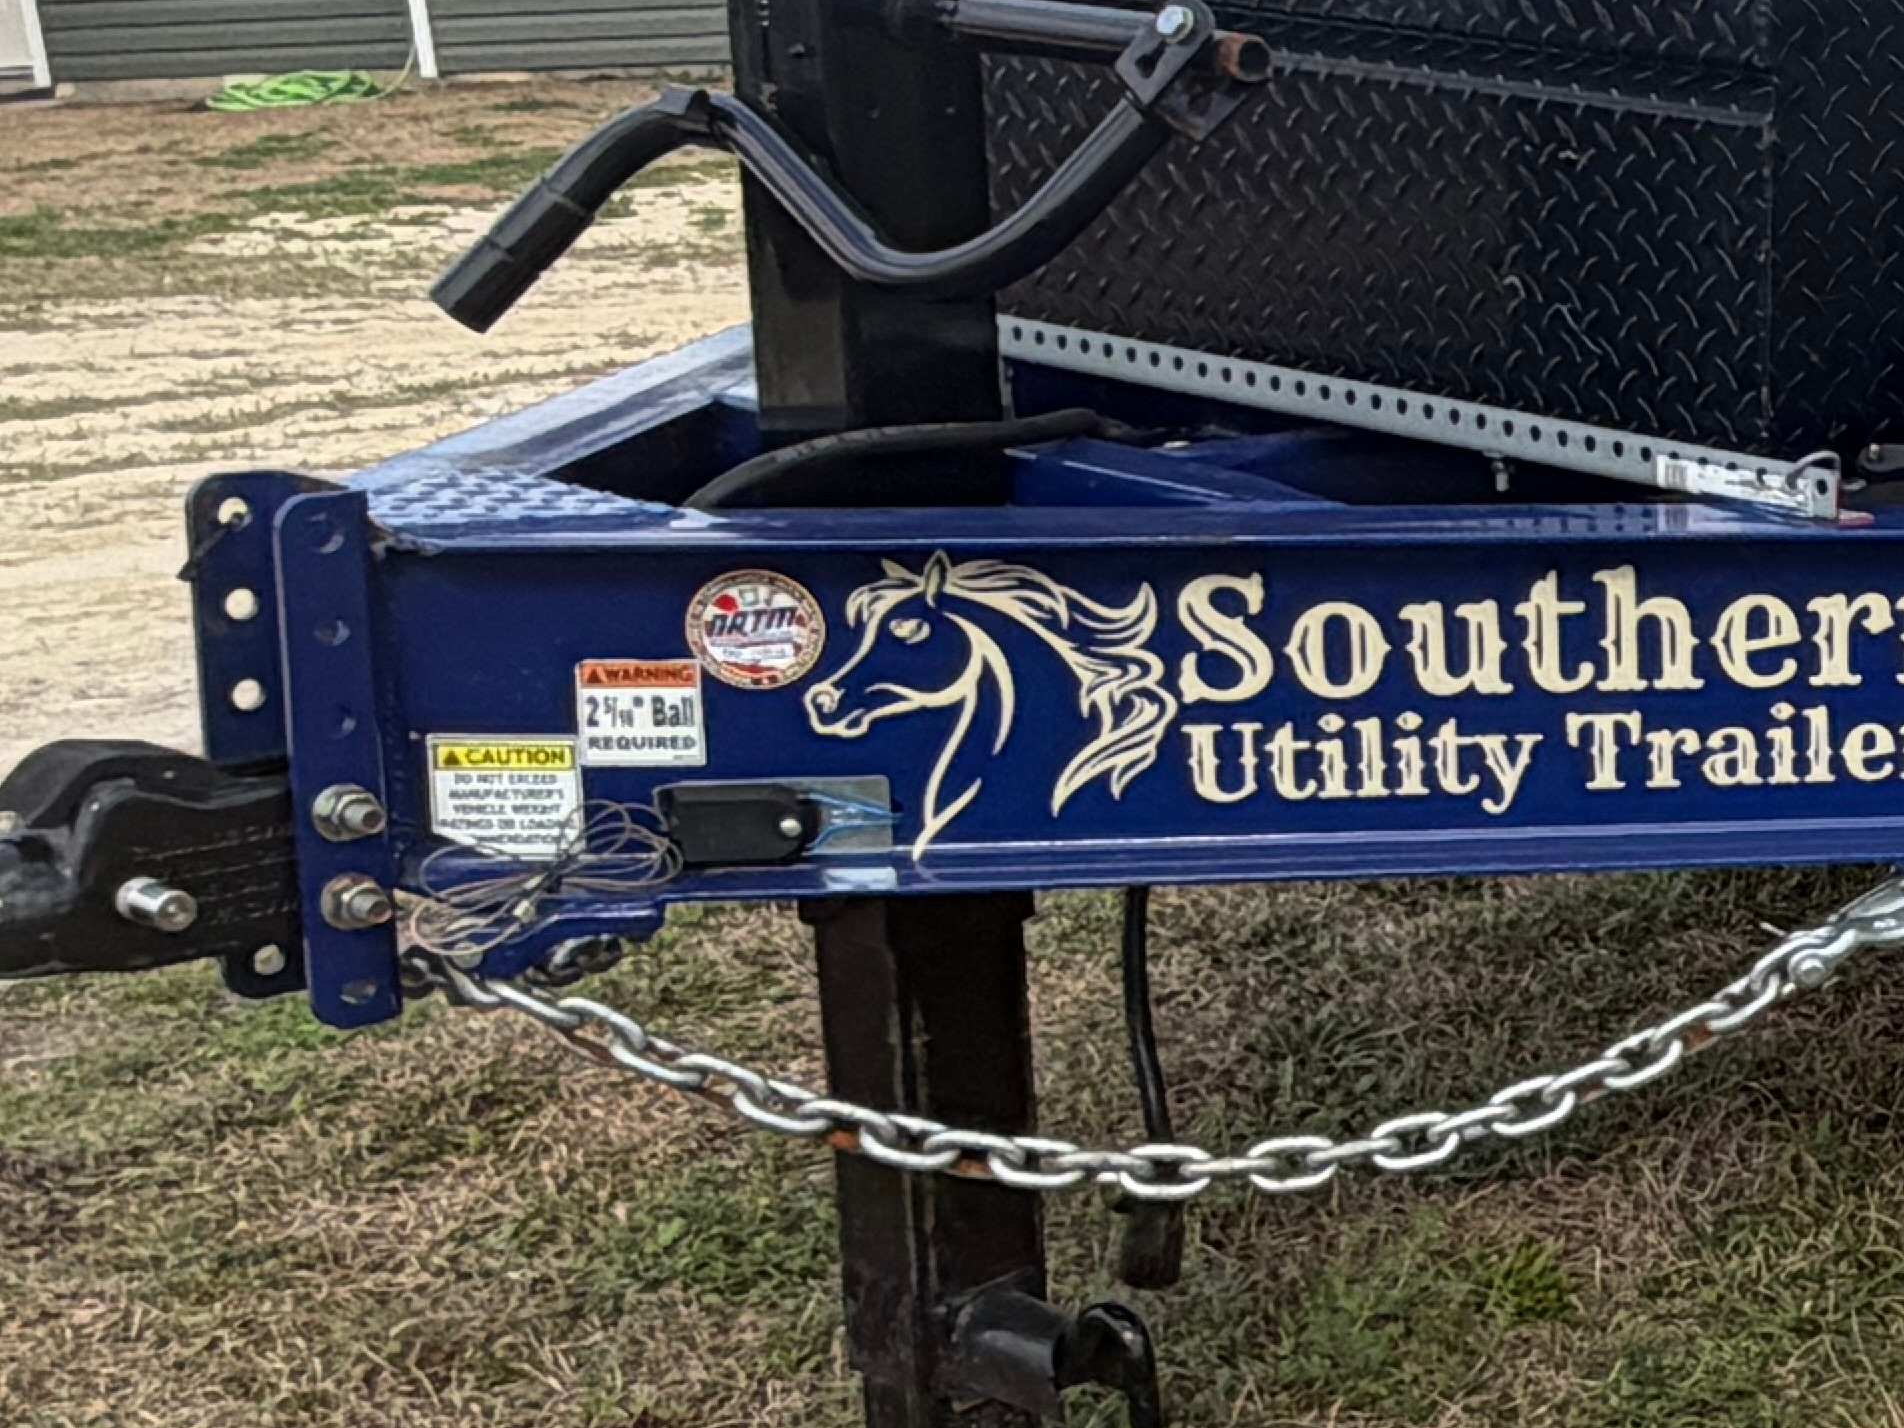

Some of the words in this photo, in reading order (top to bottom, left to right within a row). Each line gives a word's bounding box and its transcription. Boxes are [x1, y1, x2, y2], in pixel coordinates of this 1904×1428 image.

[604, 664, 694, 682] WARNING
[650, 695, 694, 728] Ball
[588, 735, 697, 751] REQUIRED
[464, 747, 566, 766] CAUTION
[1179, 710, 1545, 815] Utility
